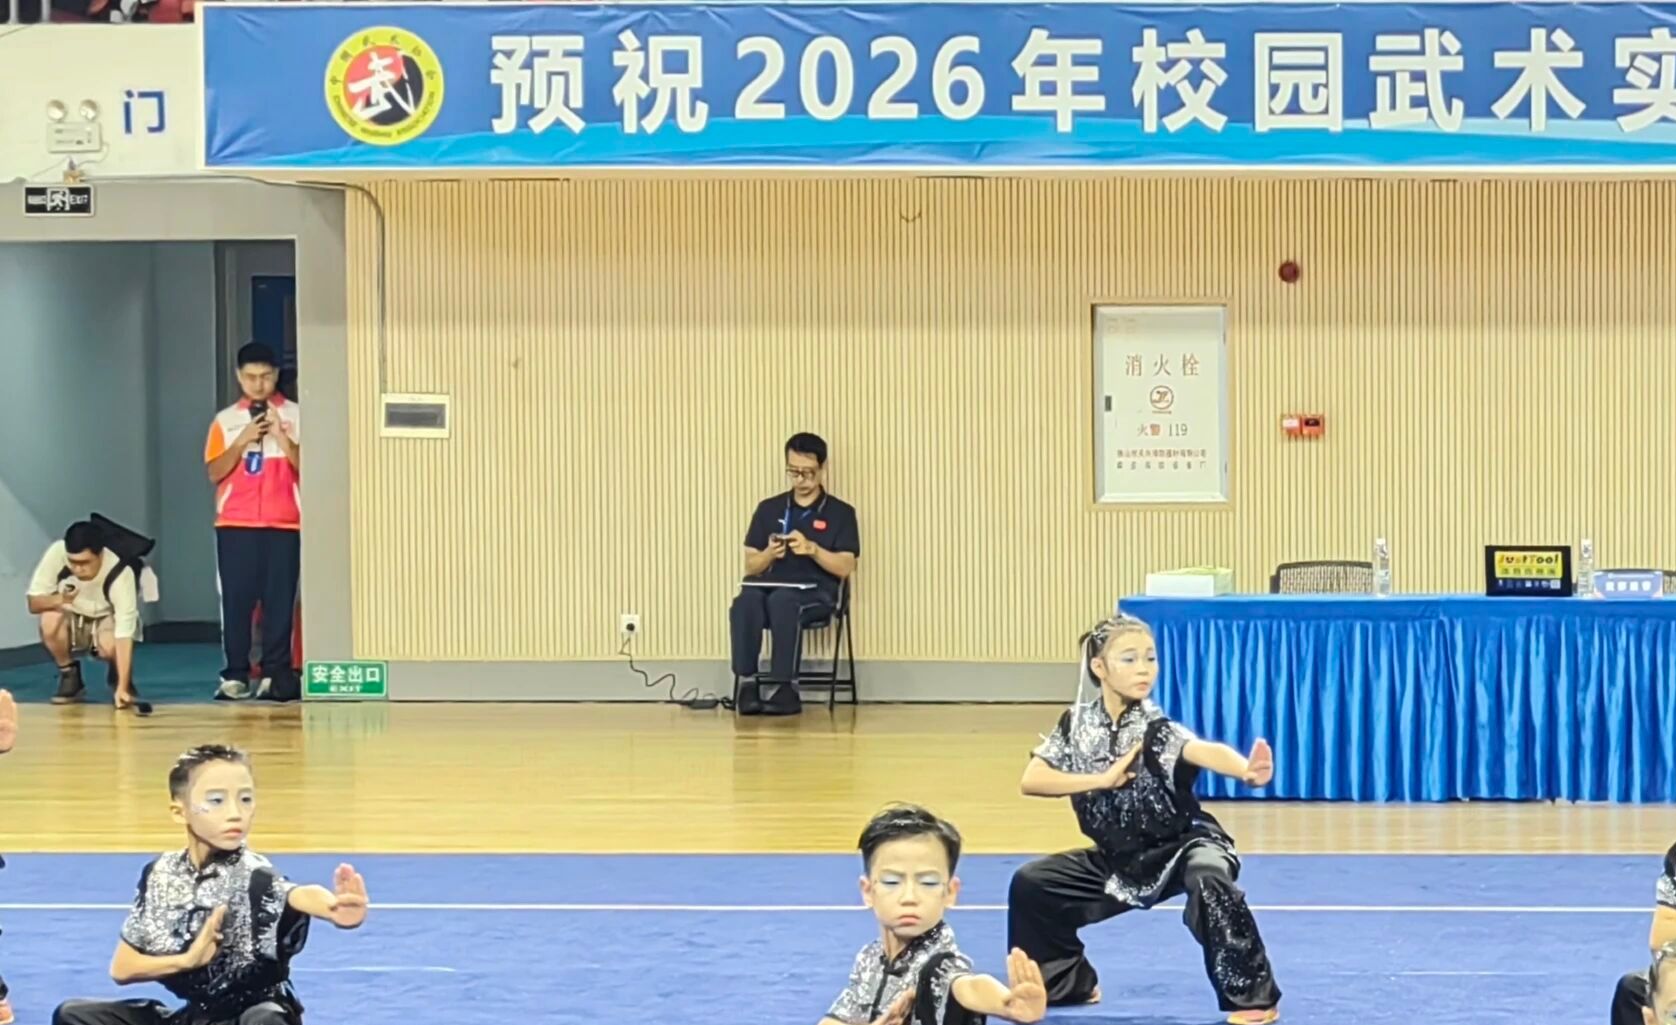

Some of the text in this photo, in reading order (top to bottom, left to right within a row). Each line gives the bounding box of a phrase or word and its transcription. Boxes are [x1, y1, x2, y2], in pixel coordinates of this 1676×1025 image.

[123, 89, 166, 134] 门
[1125, 353, 1199, 376] 消火栓
[1169, 423, 1188, 437] 119
[312, 665, 380, 683] 安全出口
